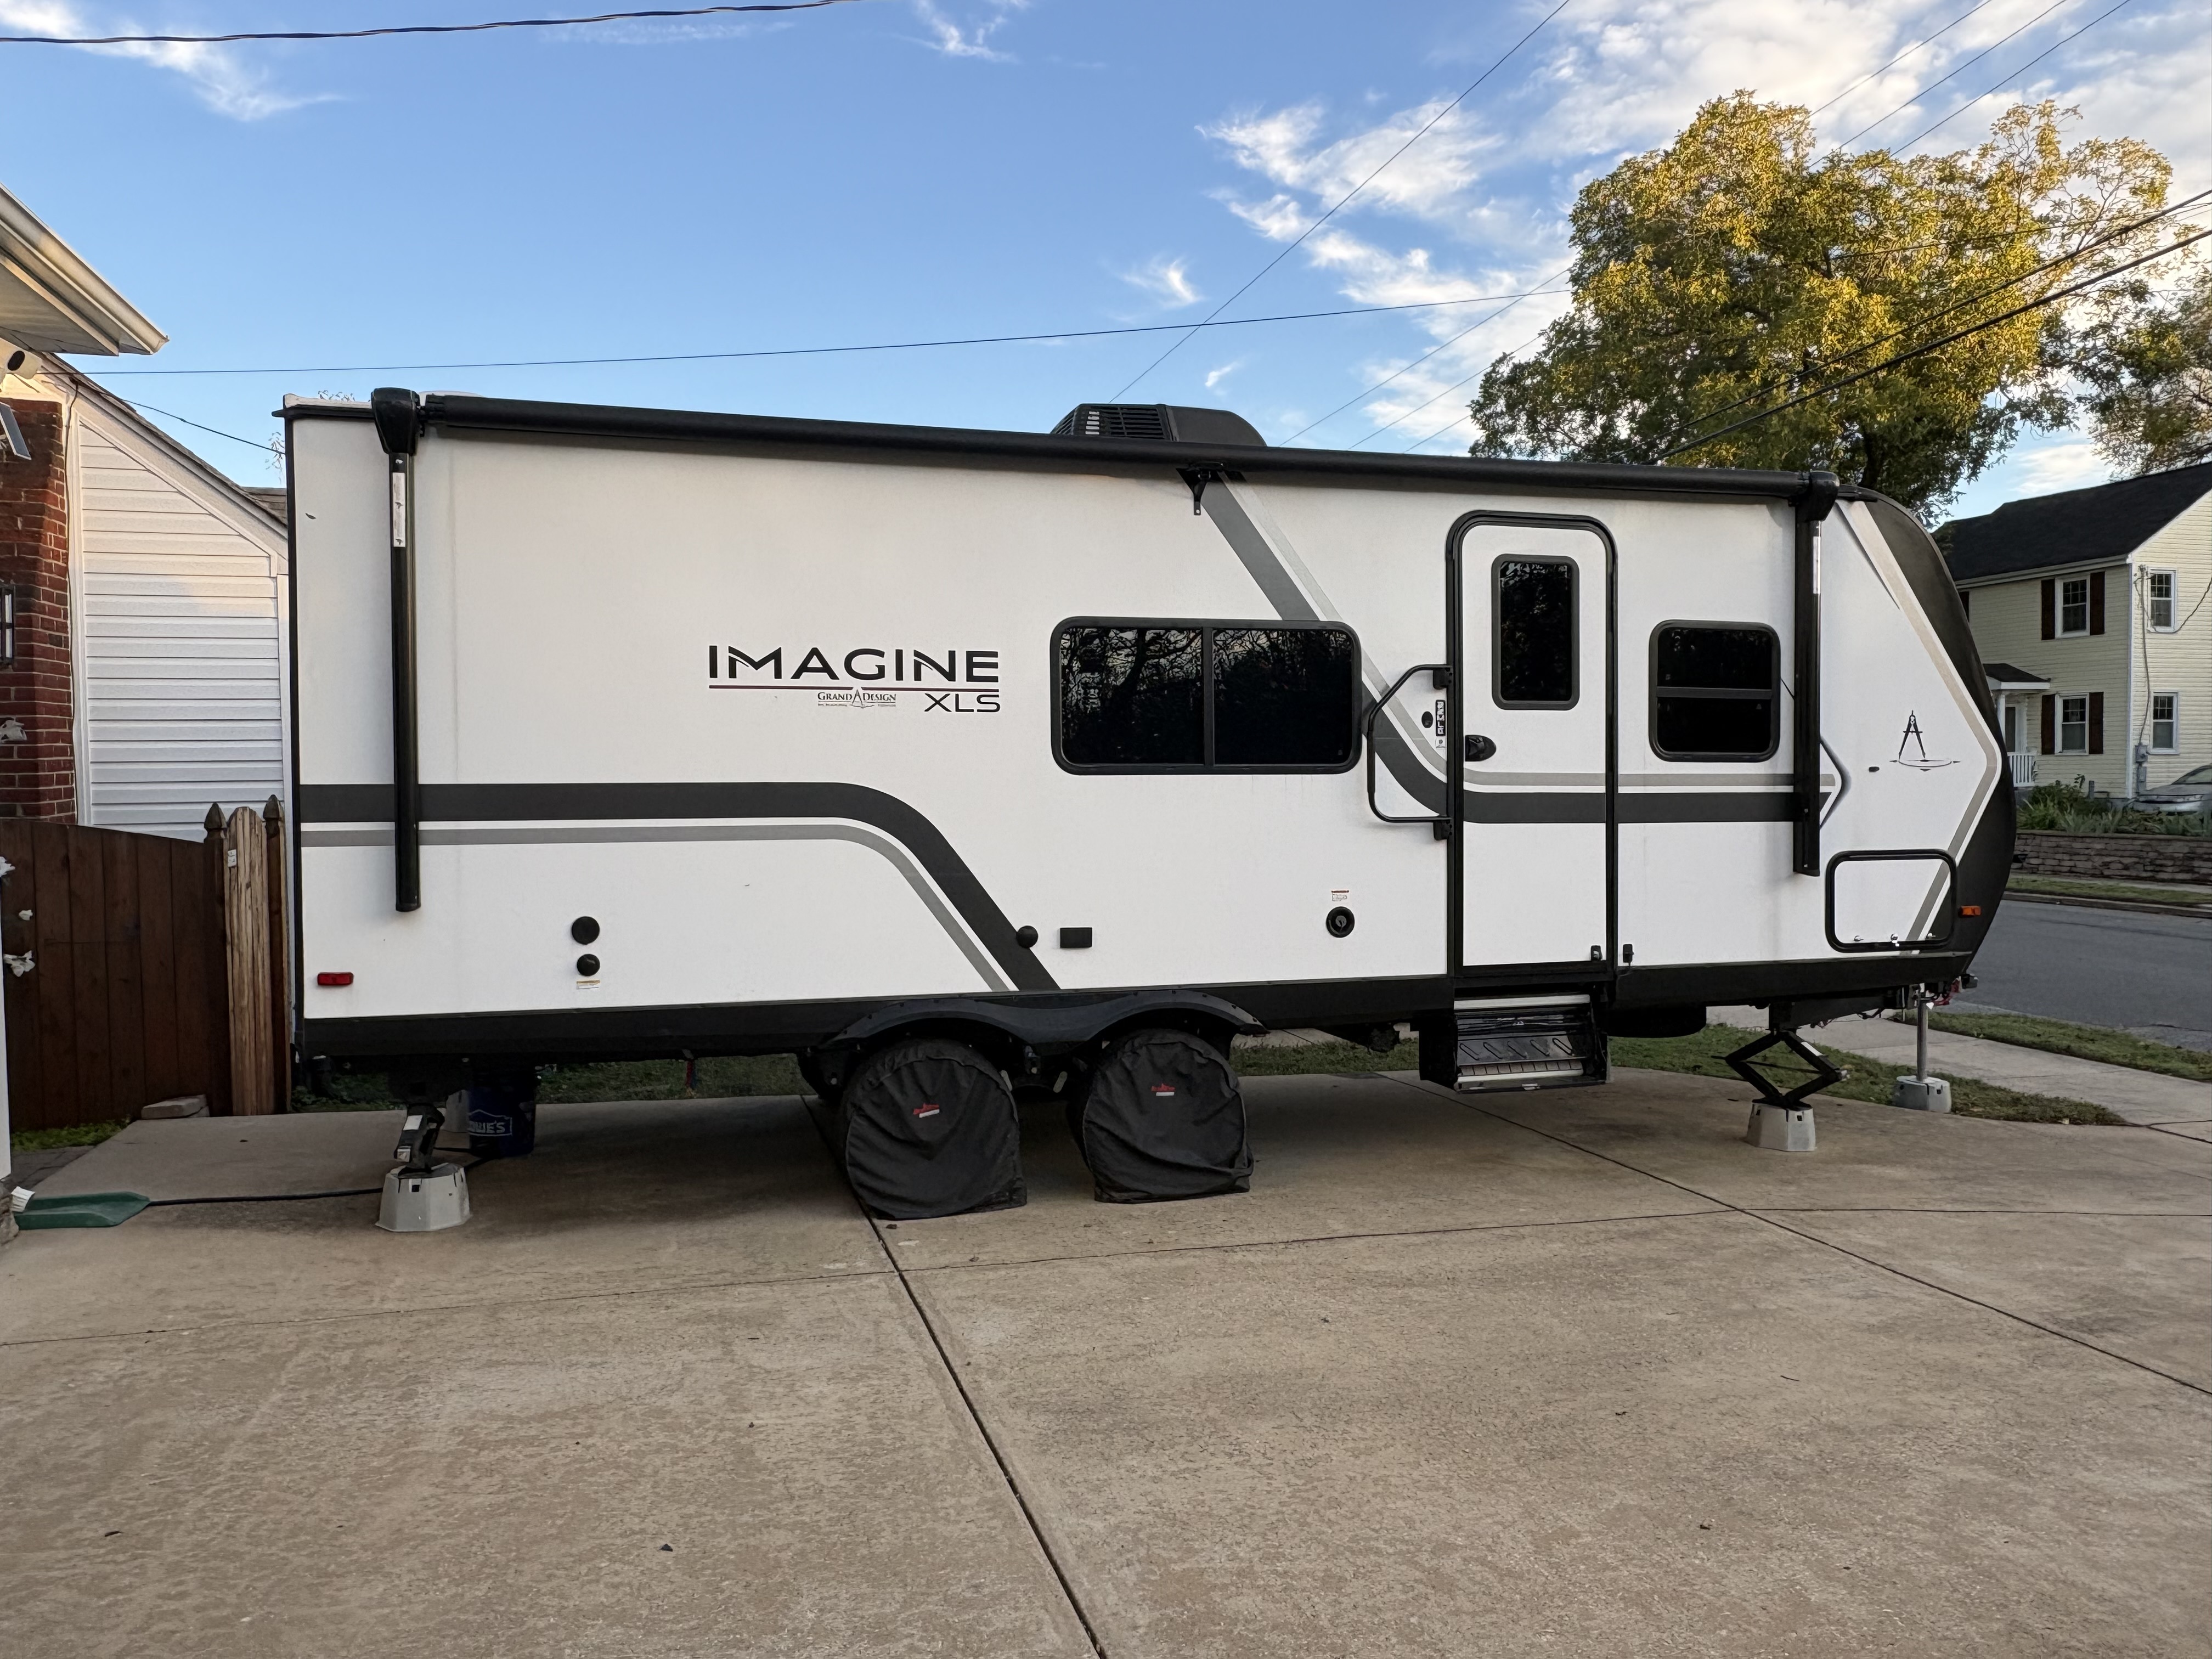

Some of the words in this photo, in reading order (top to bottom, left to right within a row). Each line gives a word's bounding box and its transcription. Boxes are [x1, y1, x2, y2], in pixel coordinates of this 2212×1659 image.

[709, 645, 999, 682] IMAGINE
[817, 692, 853, 701] GRAND
[862, 692, 896, 701] DESIGN
[924, 693, 1001, 713] XLS
[469, 1120, 506, 1134] WE'S
